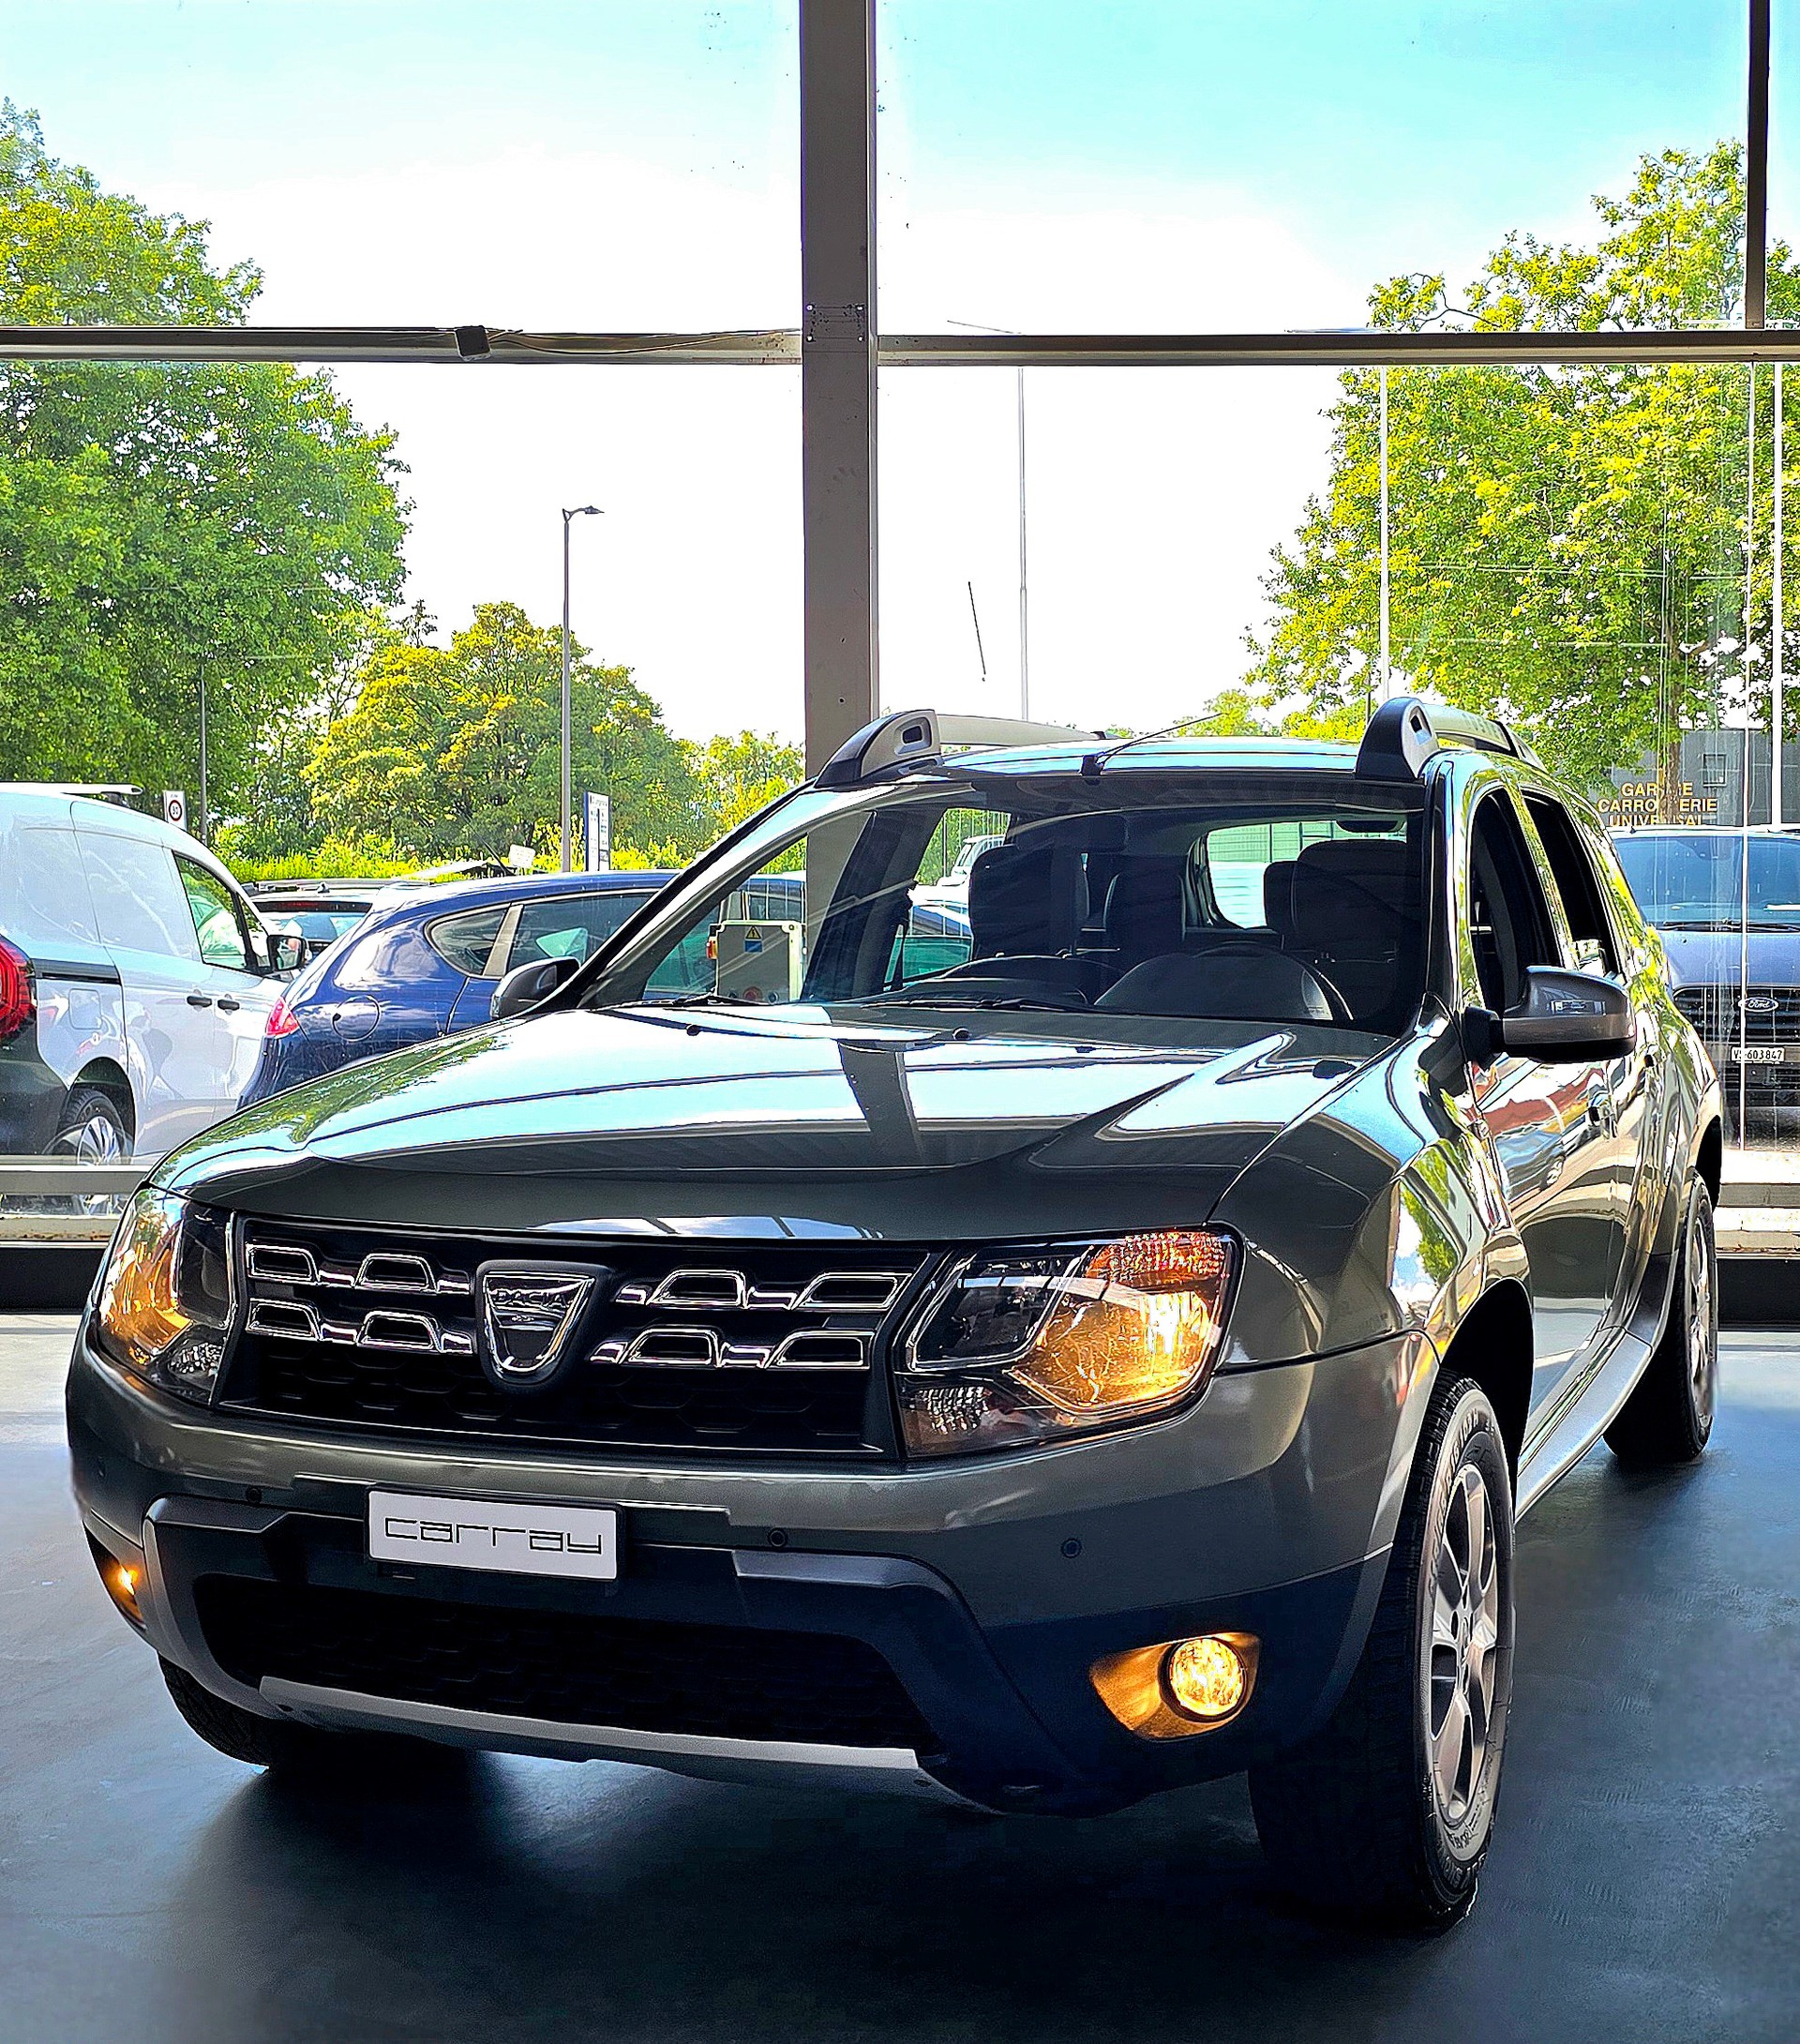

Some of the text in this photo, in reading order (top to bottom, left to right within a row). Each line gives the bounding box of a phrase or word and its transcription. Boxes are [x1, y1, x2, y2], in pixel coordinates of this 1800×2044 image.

[1621, 782, 1693, 797] GARE
[1598, 798, 1718, 812] CARROERIE
[1609, 814, 1702, 826] UNIVESAL
[1748, 999, 1770, 1009] Ford
[1747, 1049, 1783, 1060] 603847
[492, 1290, 567, 1310] DACIA
[384, 1516, 602, 1556] carray
